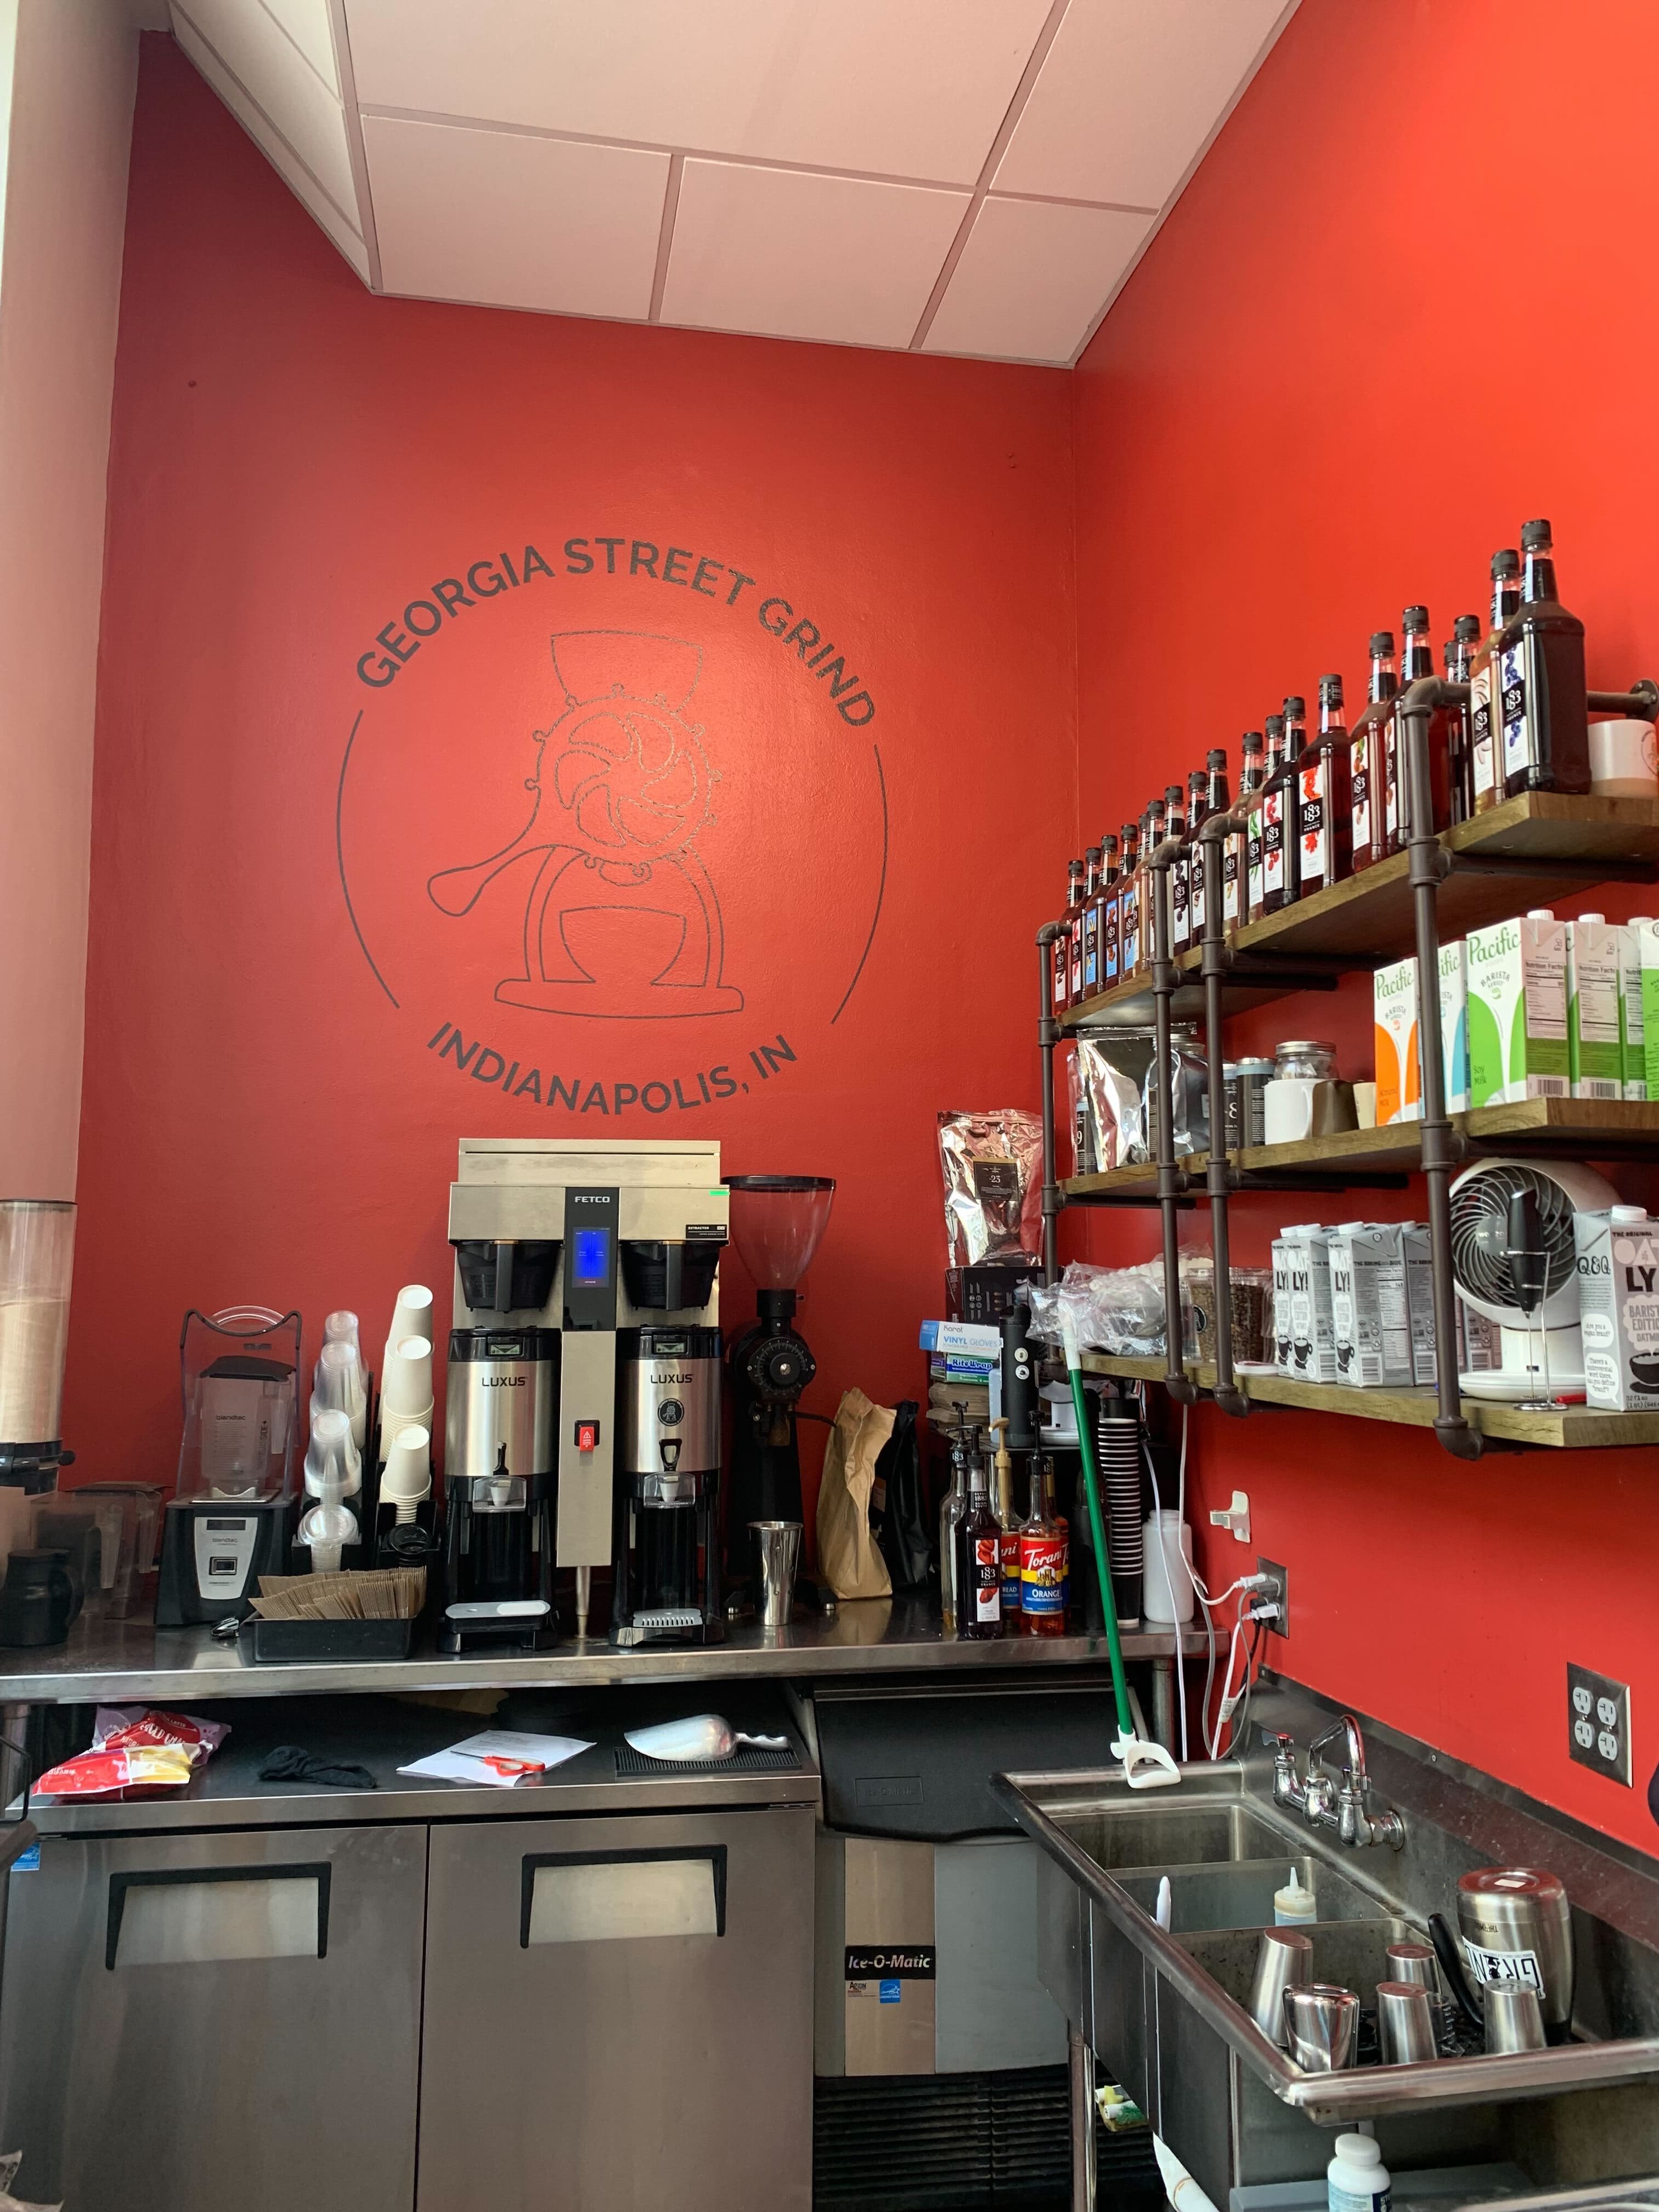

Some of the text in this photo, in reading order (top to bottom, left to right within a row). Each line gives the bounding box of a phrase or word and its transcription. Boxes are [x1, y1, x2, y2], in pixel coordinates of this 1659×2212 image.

[356, 537, 876, 727] GEORGIA STREET GRIND
[1466, 926, 1521, 966] Pacific
[1439, 949, 1460, 977] ific
[1374, 966, 1415, 1000] Pacific
[1481, 970, 1510, 988] BARISTA
[1385, 1005, 1407, 1020] BARISTA
[426, 1022, 798, 1116] INDIANAPOLIS, IN
[1474, 1065, 1486, 1075] Soy
[1293, 1271, 1308, 1291] LY!
[1335, 1271, 1350, 1292] LY!
[1628, 1305, 1659, 1318] BARIST
[943, 1325, 963, 1333] Karat
[1632, 1318, 1659, 1331] EDITIO
[943, 1336, 998, 1347] VINYL GLOVES
[482, 1376, 526, 1387] LUXUS
[651, 1374, 693, 1384] LUXUS
[1024, 1547, 1062, 1572] Torani
[1031, 1589, 1060, 1598] ORANGE
[170, 1719, 187, 1728] LATTE
[848, 1954, 931, 1969] Ice-O-Matic
